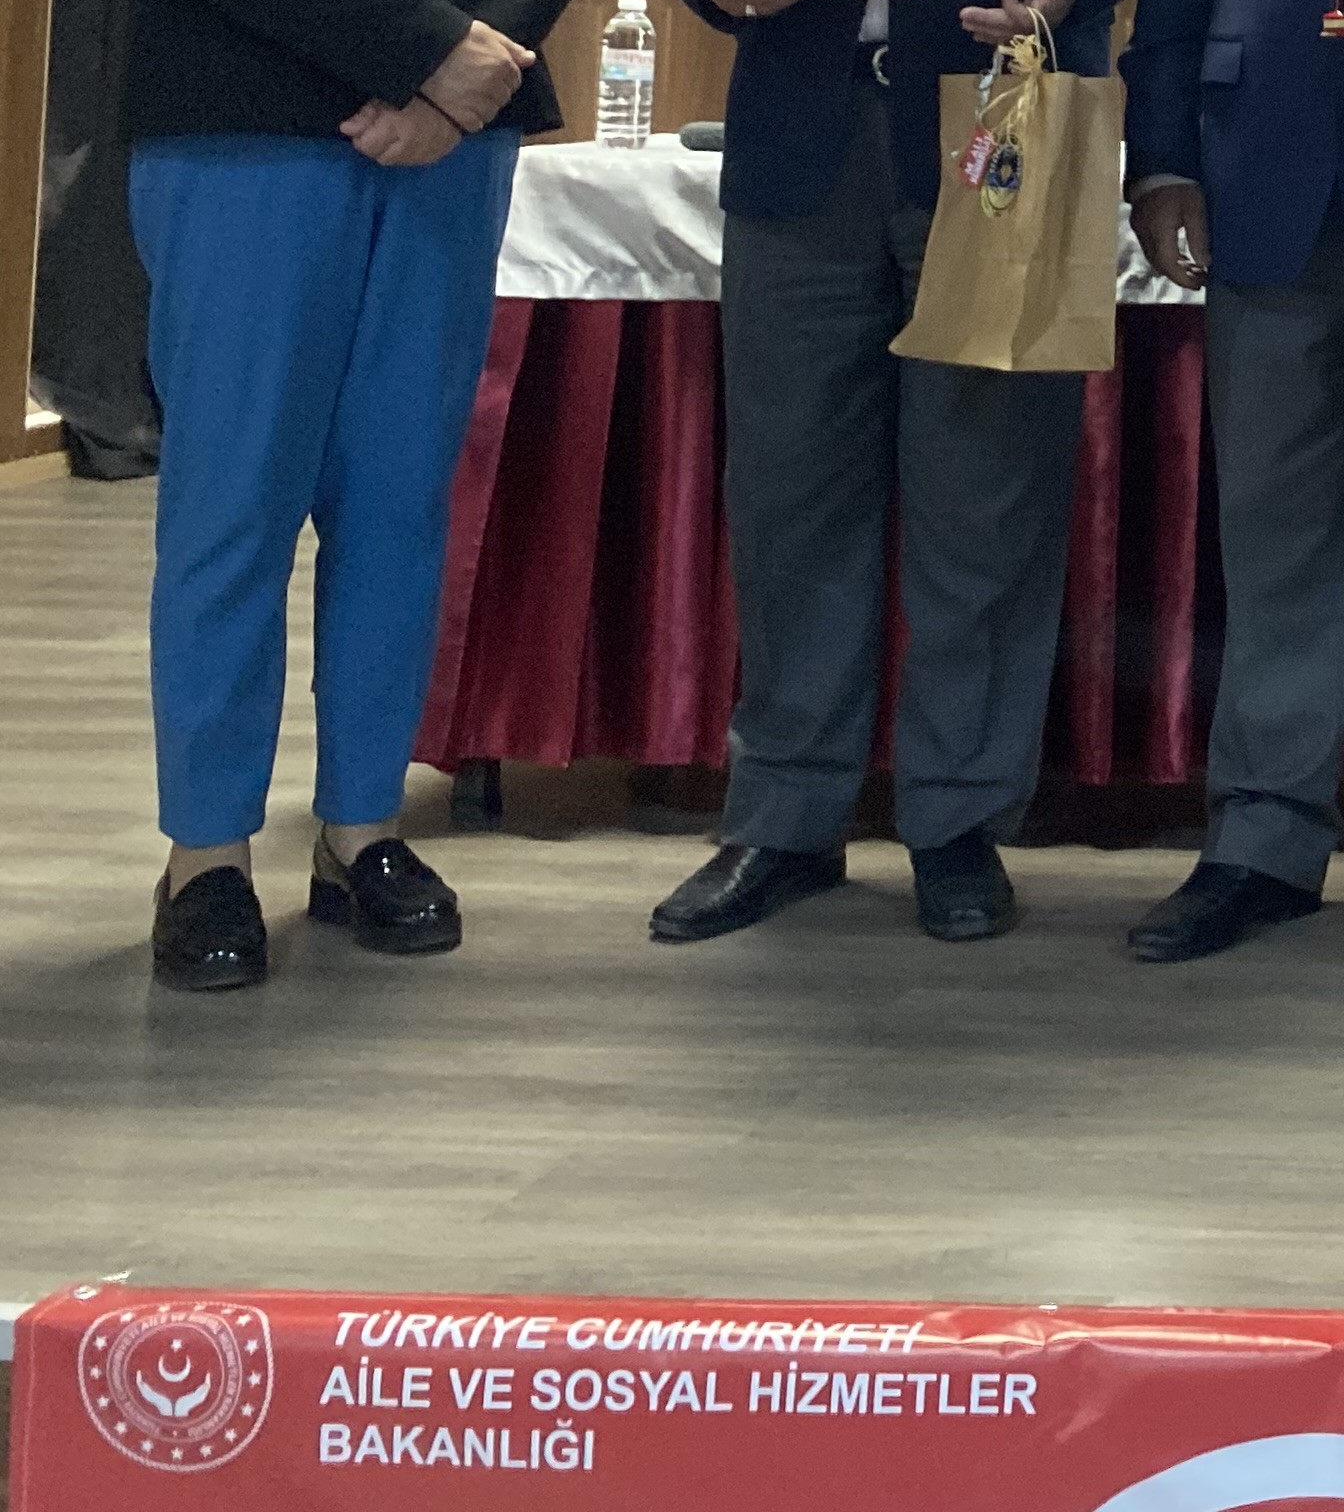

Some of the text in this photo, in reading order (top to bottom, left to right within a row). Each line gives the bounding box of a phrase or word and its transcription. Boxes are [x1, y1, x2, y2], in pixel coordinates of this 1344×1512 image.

[334, 1309, 924, 1353] TÜRKİYE CUMHURİYETİ
[319, 1355, 1038, 1416] AİLE VE SOSYAL HİZMETLER
[319, 1417, 595, 1471] BAKANLIĞI
